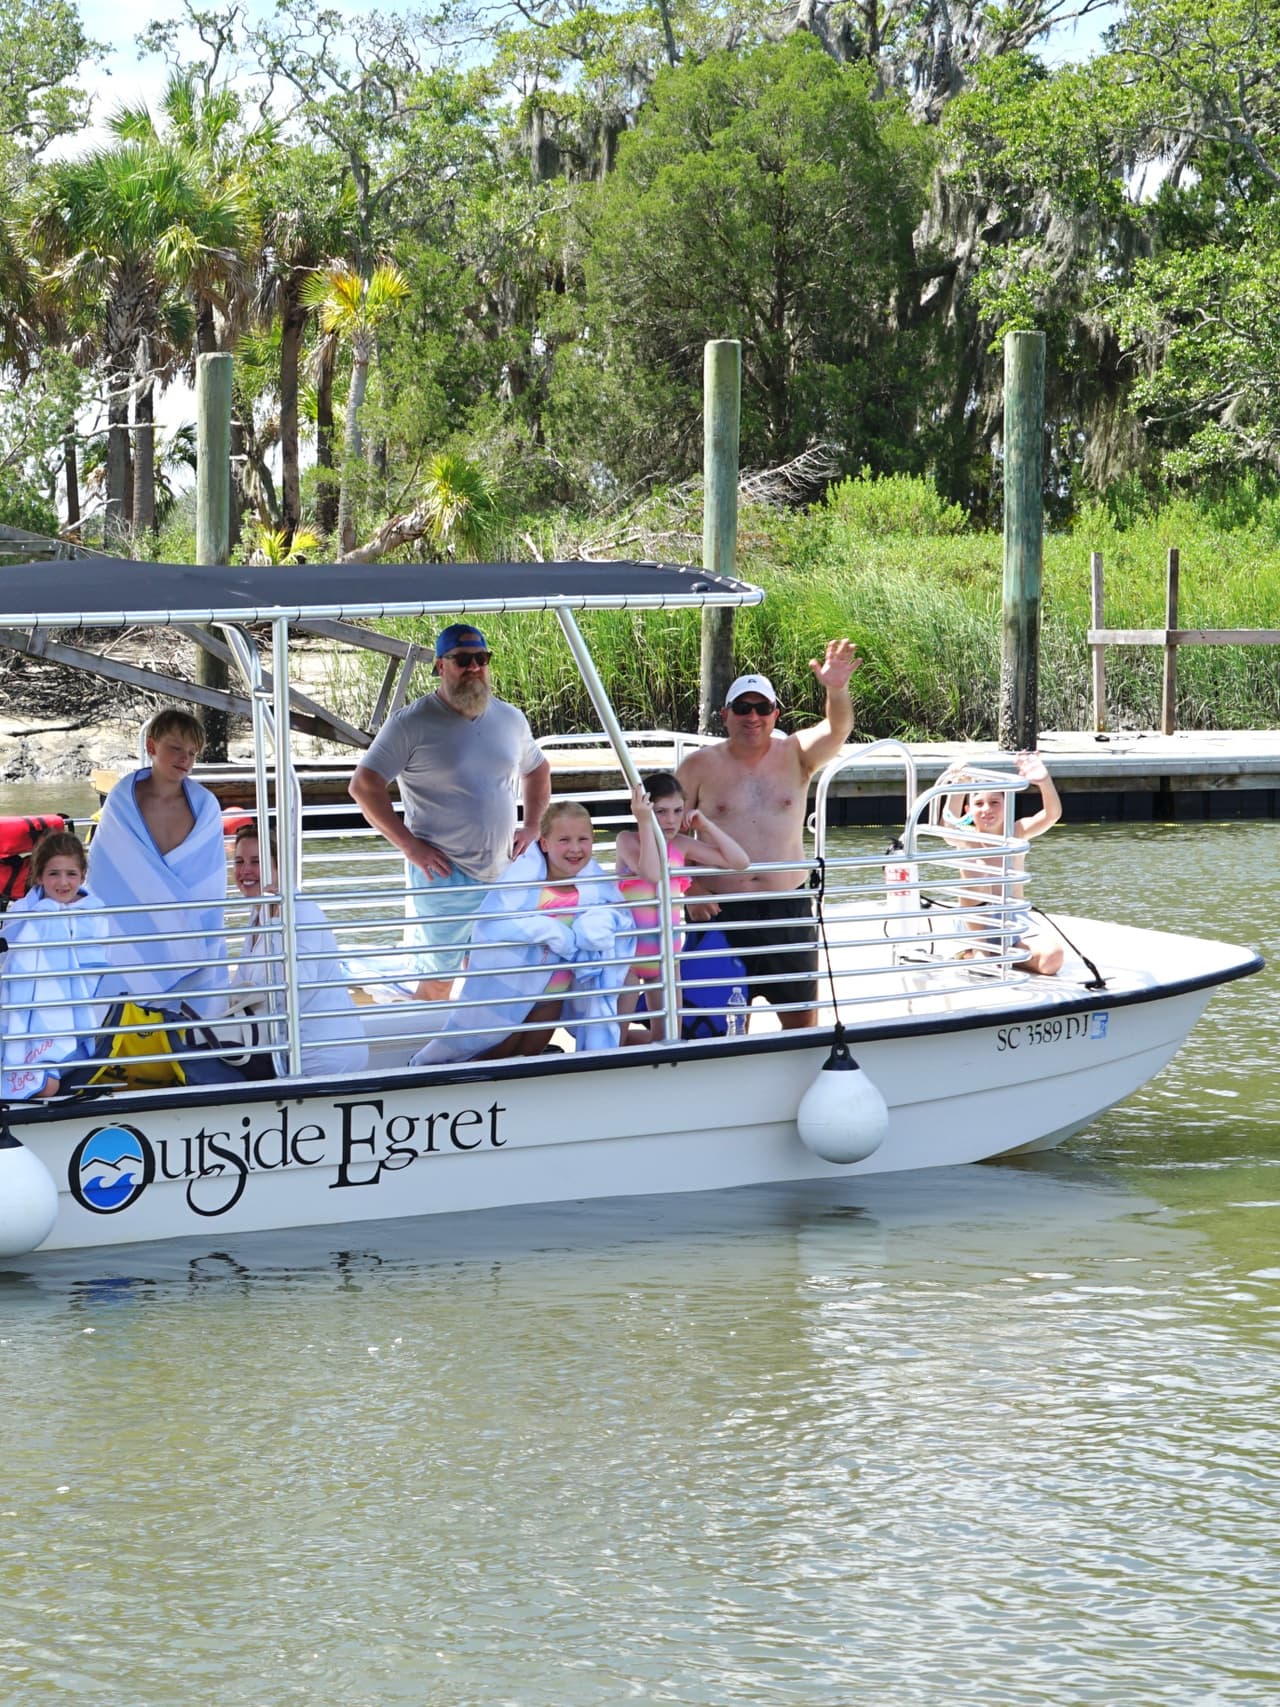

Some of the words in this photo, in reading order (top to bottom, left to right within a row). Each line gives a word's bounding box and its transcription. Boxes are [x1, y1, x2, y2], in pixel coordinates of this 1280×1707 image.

[996, 1027, 1021, 1051] SC
[1026, 1020, 1063, 1045] 3589
[67, 1105, 325, 1217] Outside
[329, 1099, 508, 1189] Egret
